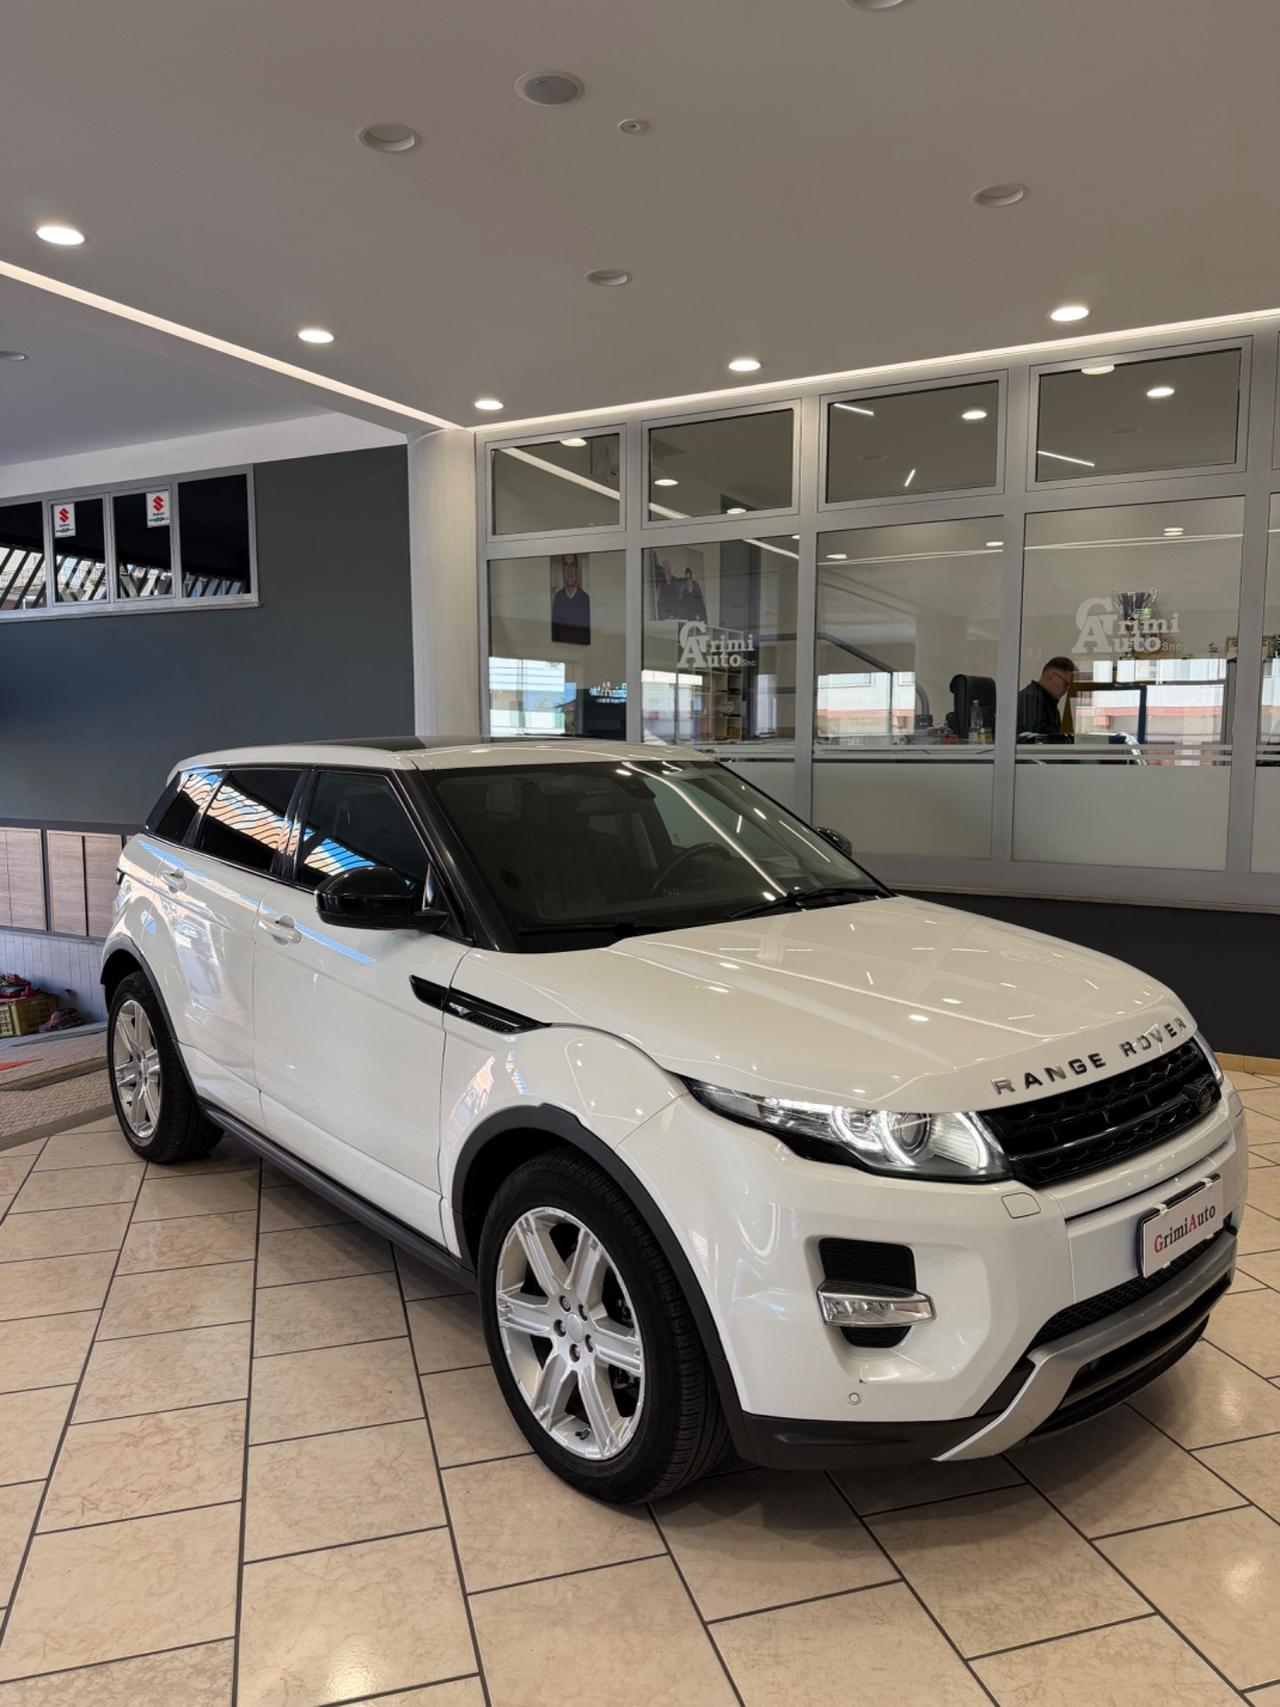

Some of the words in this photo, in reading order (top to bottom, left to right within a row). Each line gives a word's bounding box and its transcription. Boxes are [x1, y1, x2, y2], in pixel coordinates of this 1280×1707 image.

[1072, 615, 1161, 653] Auto
[1076, 597, 1180, 634] Grimi
[677, 636, 741, 667] Auto
[679, 620, 755, 652] Grimi
[991, 1053, 1106, 1095] RANGE
[1119, 1016, 1187, 1057] ROVER
[1154, 1205, 1216, 1253] GrimiAuto
